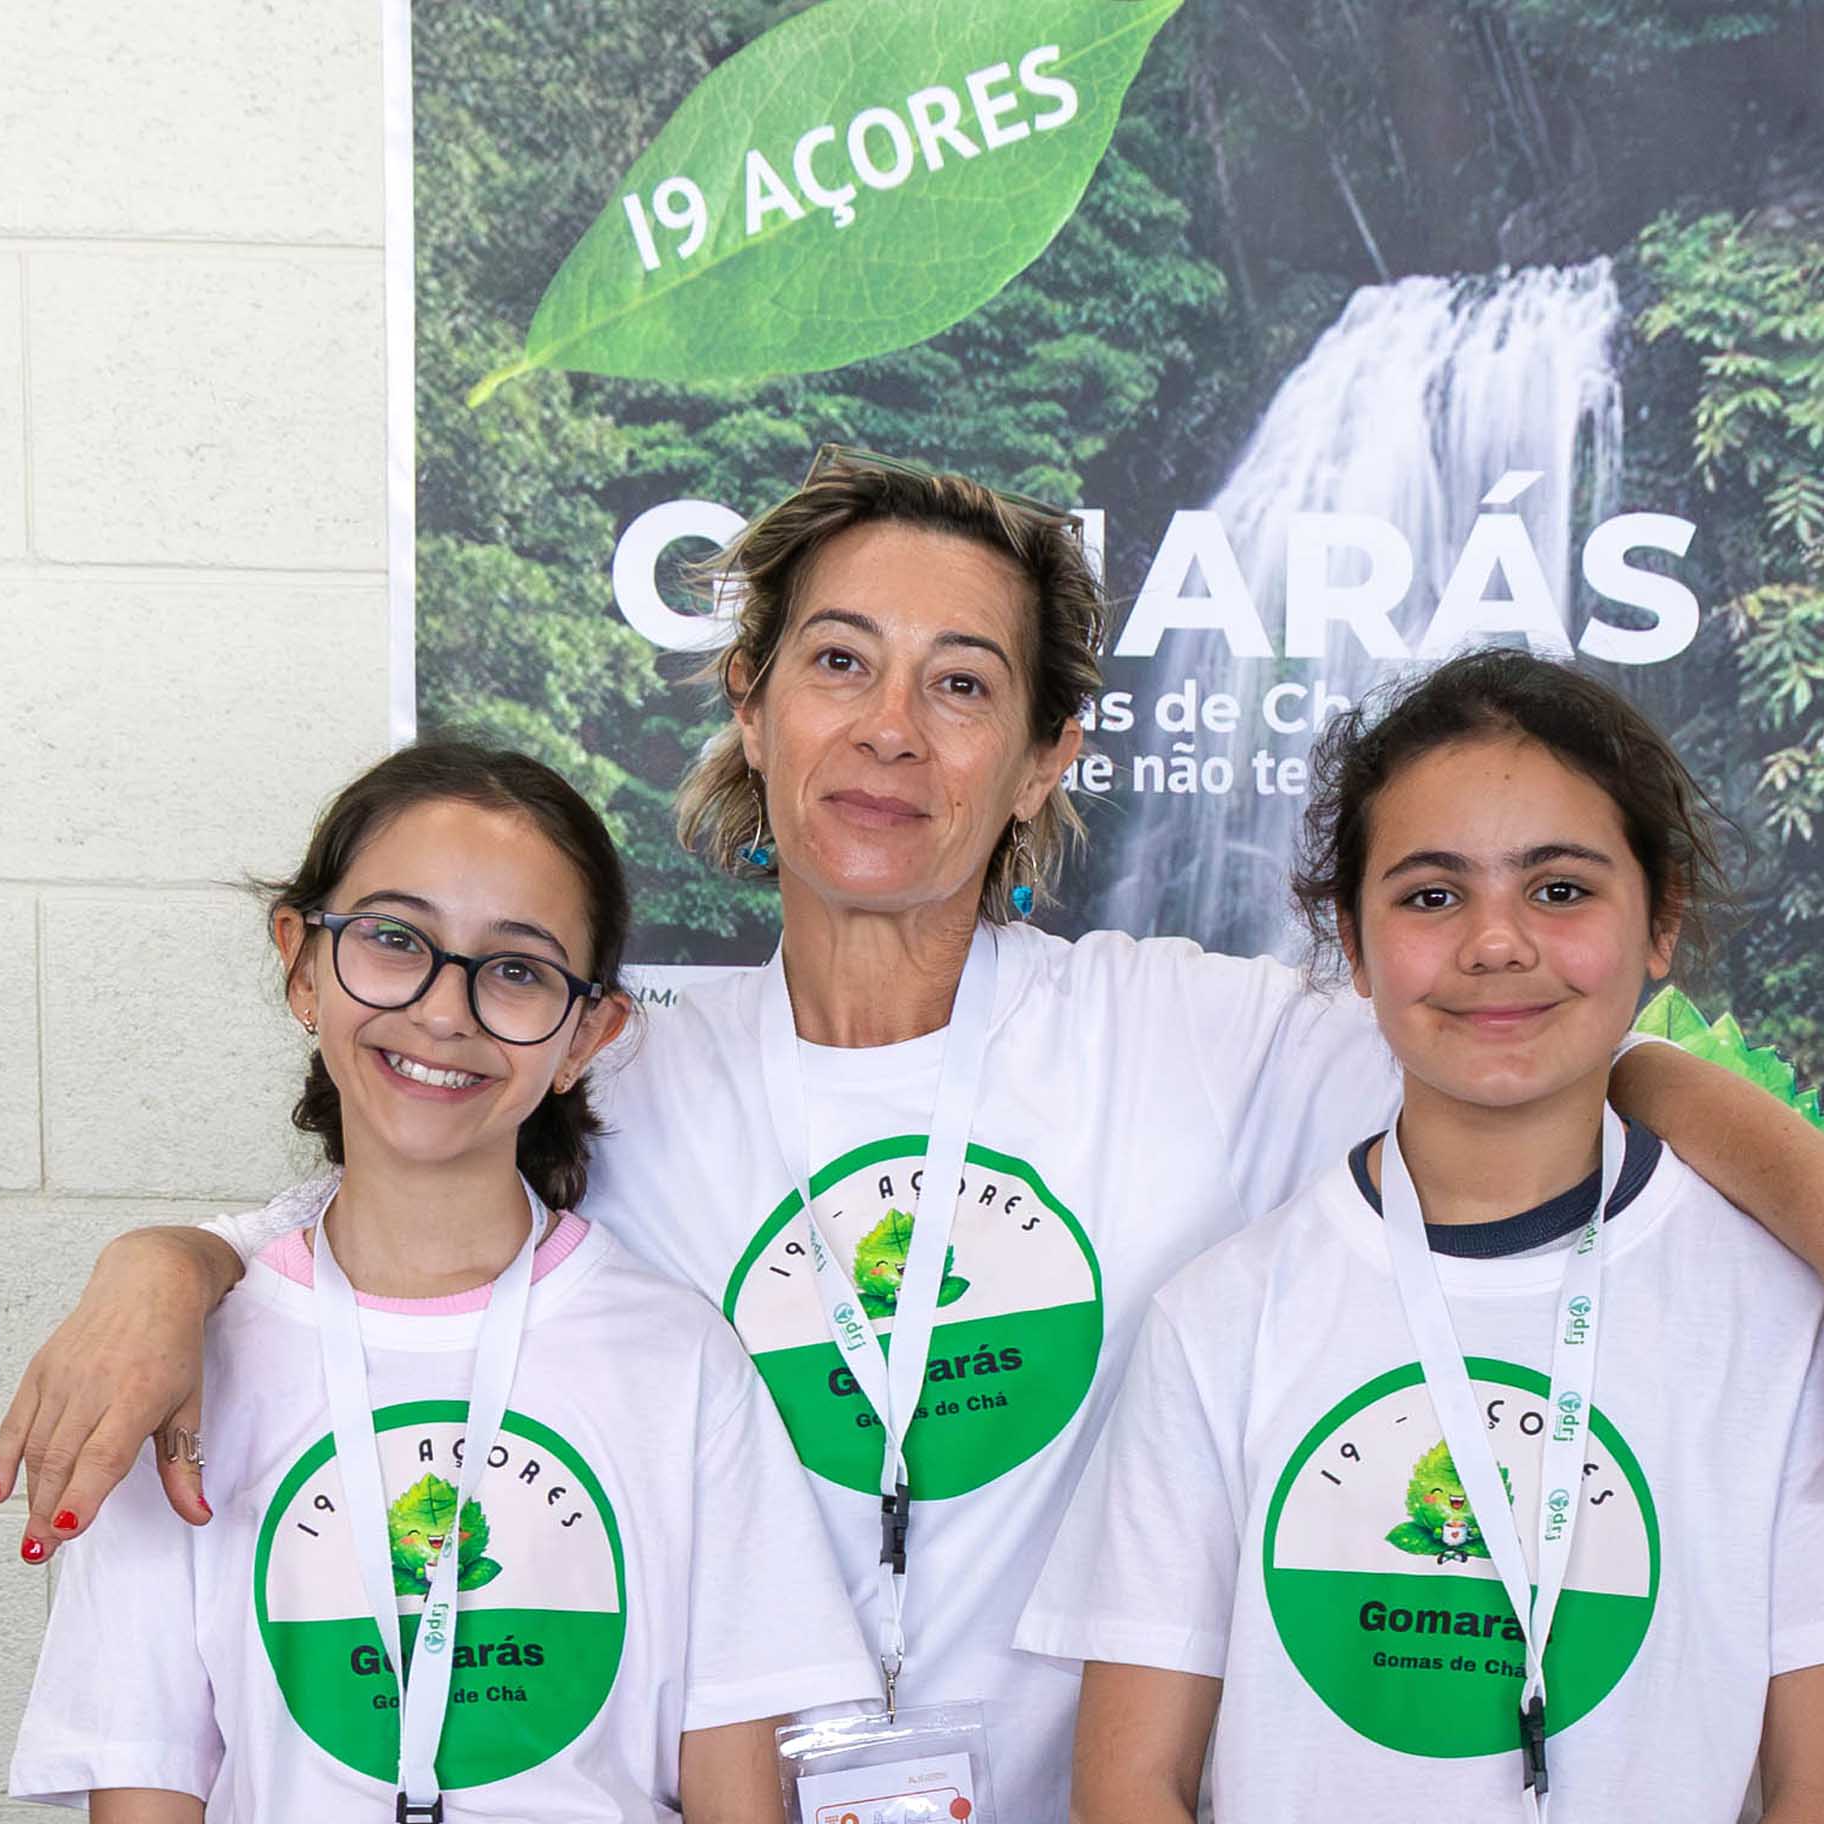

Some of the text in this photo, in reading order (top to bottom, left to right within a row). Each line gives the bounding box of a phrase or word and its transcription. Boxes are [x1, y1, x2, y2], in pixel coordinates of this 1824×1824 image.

[743, 45, 1079, 234] AÇORES
[613, 470, 1701, 665] GARÁS
[1155, 679, 1241, 733] de
[1133, 742, 1234, 795] não
[828, 1344, 1023, 1397] Garás
[935, 1401, 960, 1416] de
[966, 1392, 1009, 1412] Chá
[1372, 1651, 1444, 1670] Gomas
[1449, 1656, 1476, 1672] de
[453, 1684, 529, 1705] de Chá
